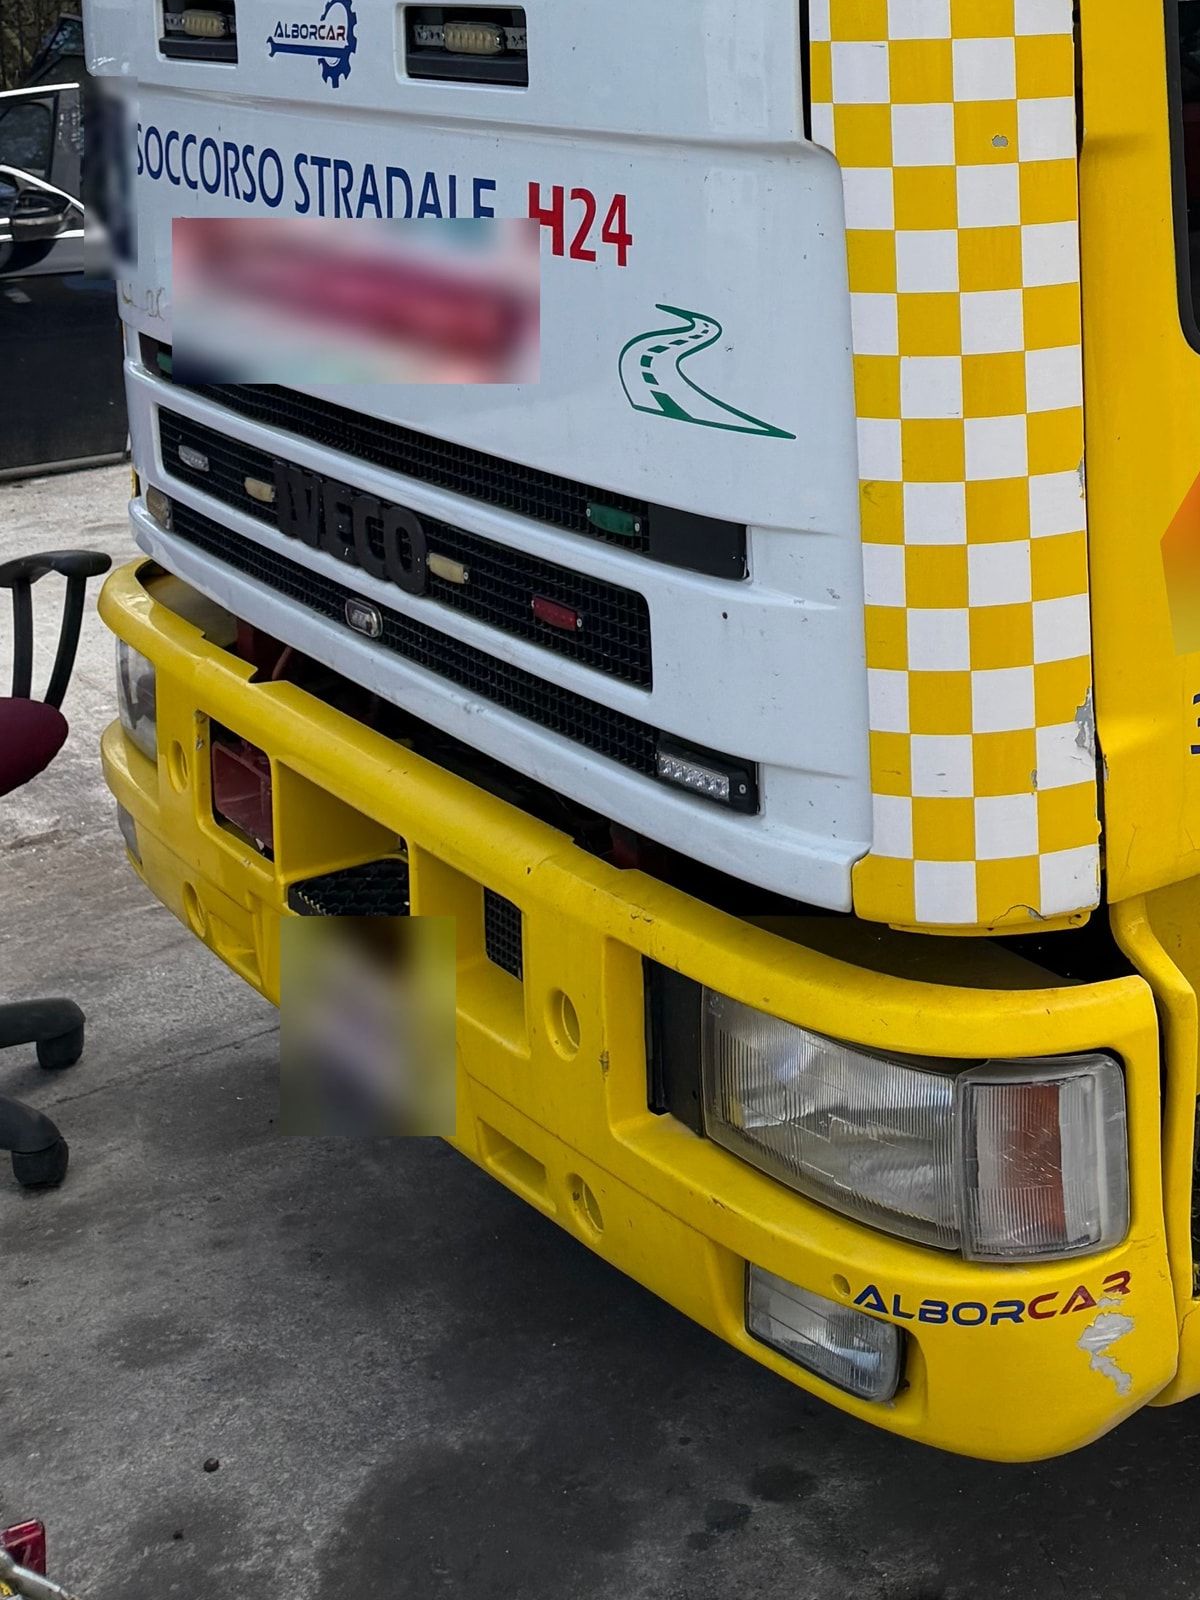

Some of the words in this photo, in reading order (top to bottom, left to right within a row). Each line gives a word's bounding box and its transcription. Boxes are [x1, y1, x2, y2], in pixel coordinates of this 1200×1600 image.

[273, 20, 346, 42] ALBORCAR
[527, 180, 634, 268] H24
[272, 454, 427, 597] IVECO
[852, 1269, 1132, 1327] ALBORCAR
